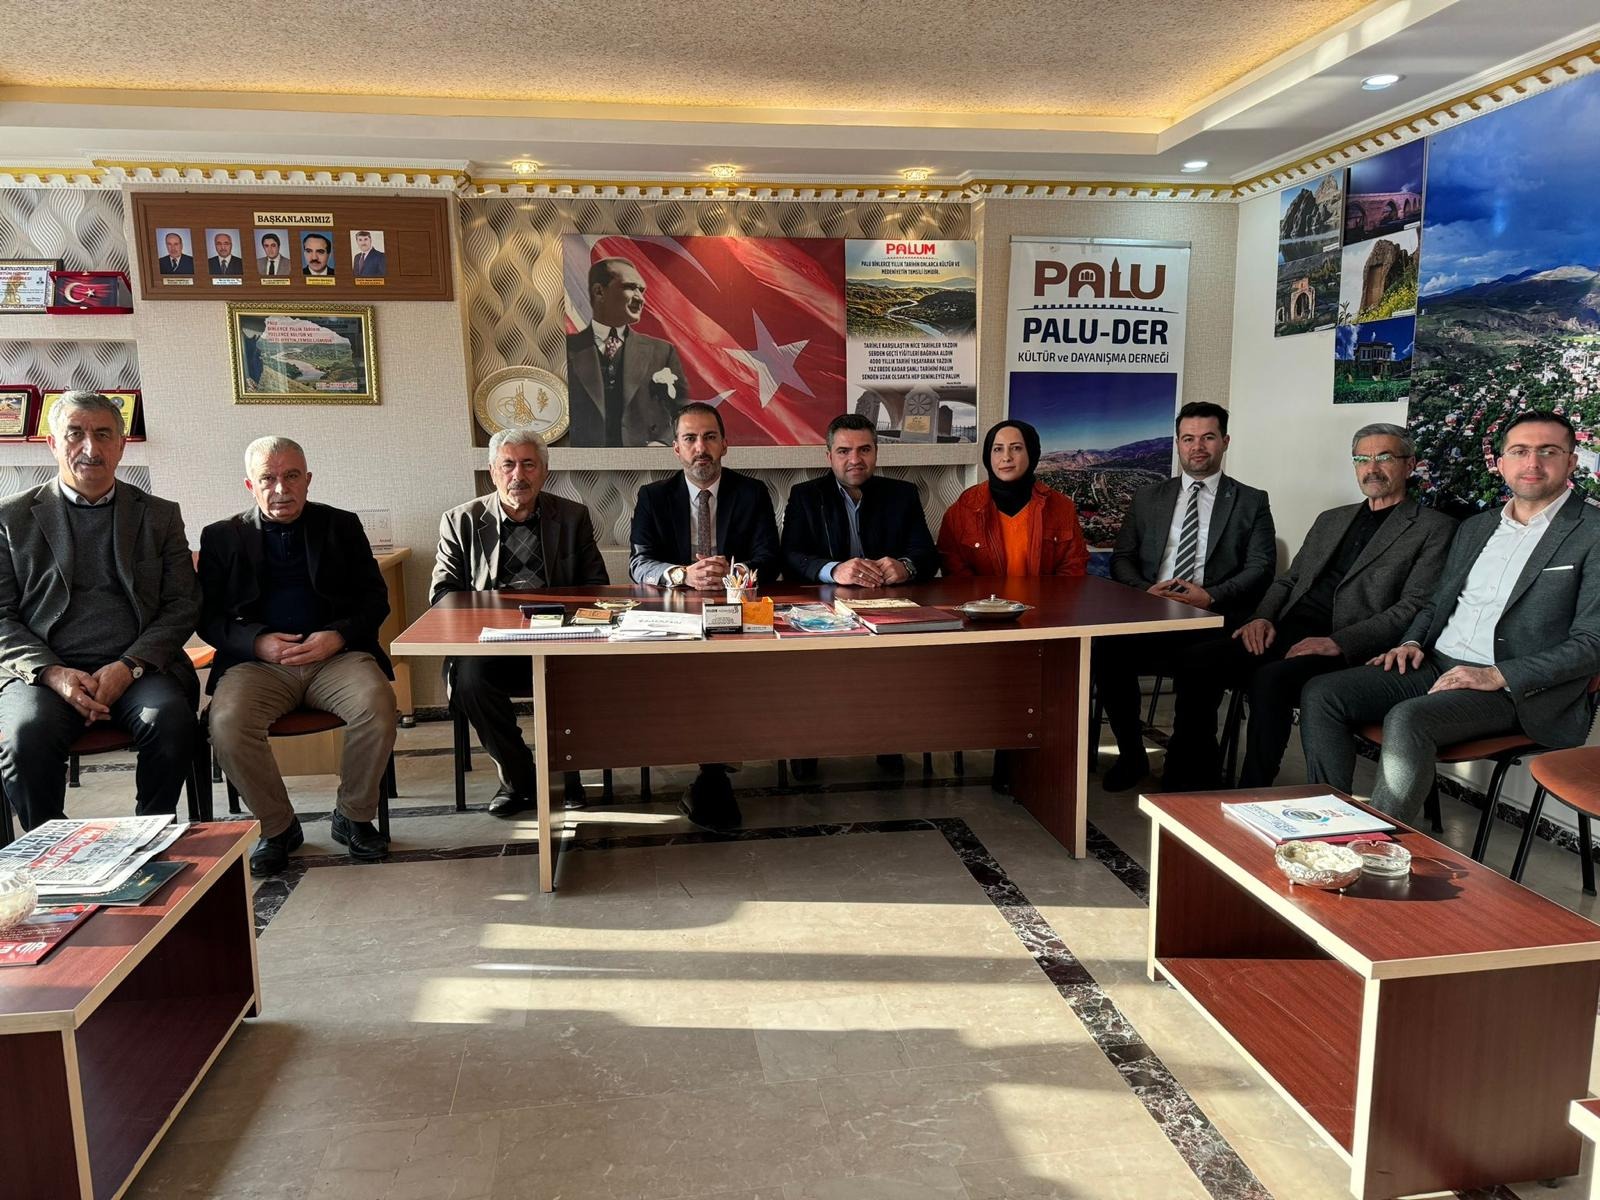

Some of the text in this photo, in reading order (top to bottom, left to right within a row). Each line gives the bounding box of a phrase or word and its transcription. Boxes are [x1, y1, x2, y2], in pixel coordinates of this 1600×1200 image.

[258, 216, 330, 224] BAŞKANLARIMIZ
[886, 242, 936, 255] PALUM
[1034, 257, 1166, 300] PALU
[1023, 318, 1168, 345] PALU-DER
[1018, 350, 1056, 362] KÜLTÜR
[1071, 352, 1126, 365] DAYANIŞMA
[1128, 352, 1169, 363] DERNEĞİ
